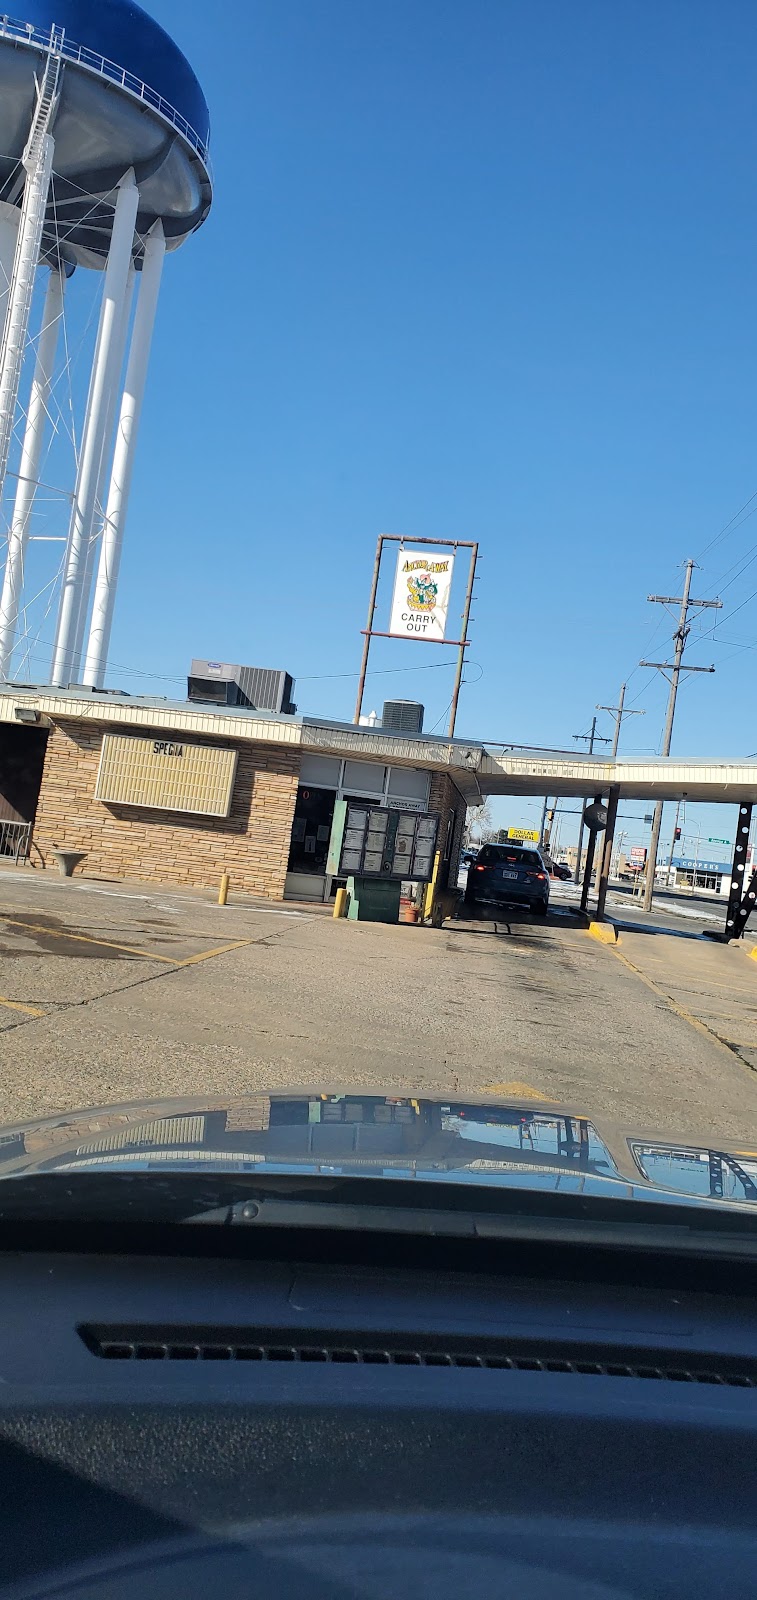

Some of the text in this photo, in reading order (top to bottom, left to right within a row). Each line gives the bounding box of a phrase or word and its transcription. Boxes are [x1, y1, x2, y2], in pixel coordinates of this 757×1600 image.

[401, 612, 436, 624] CARRY
[406, 622, 428, 633] OUT
[511, 833, 534, 841] GENERAL
[682, 861, 719, 870] COOPER'S
